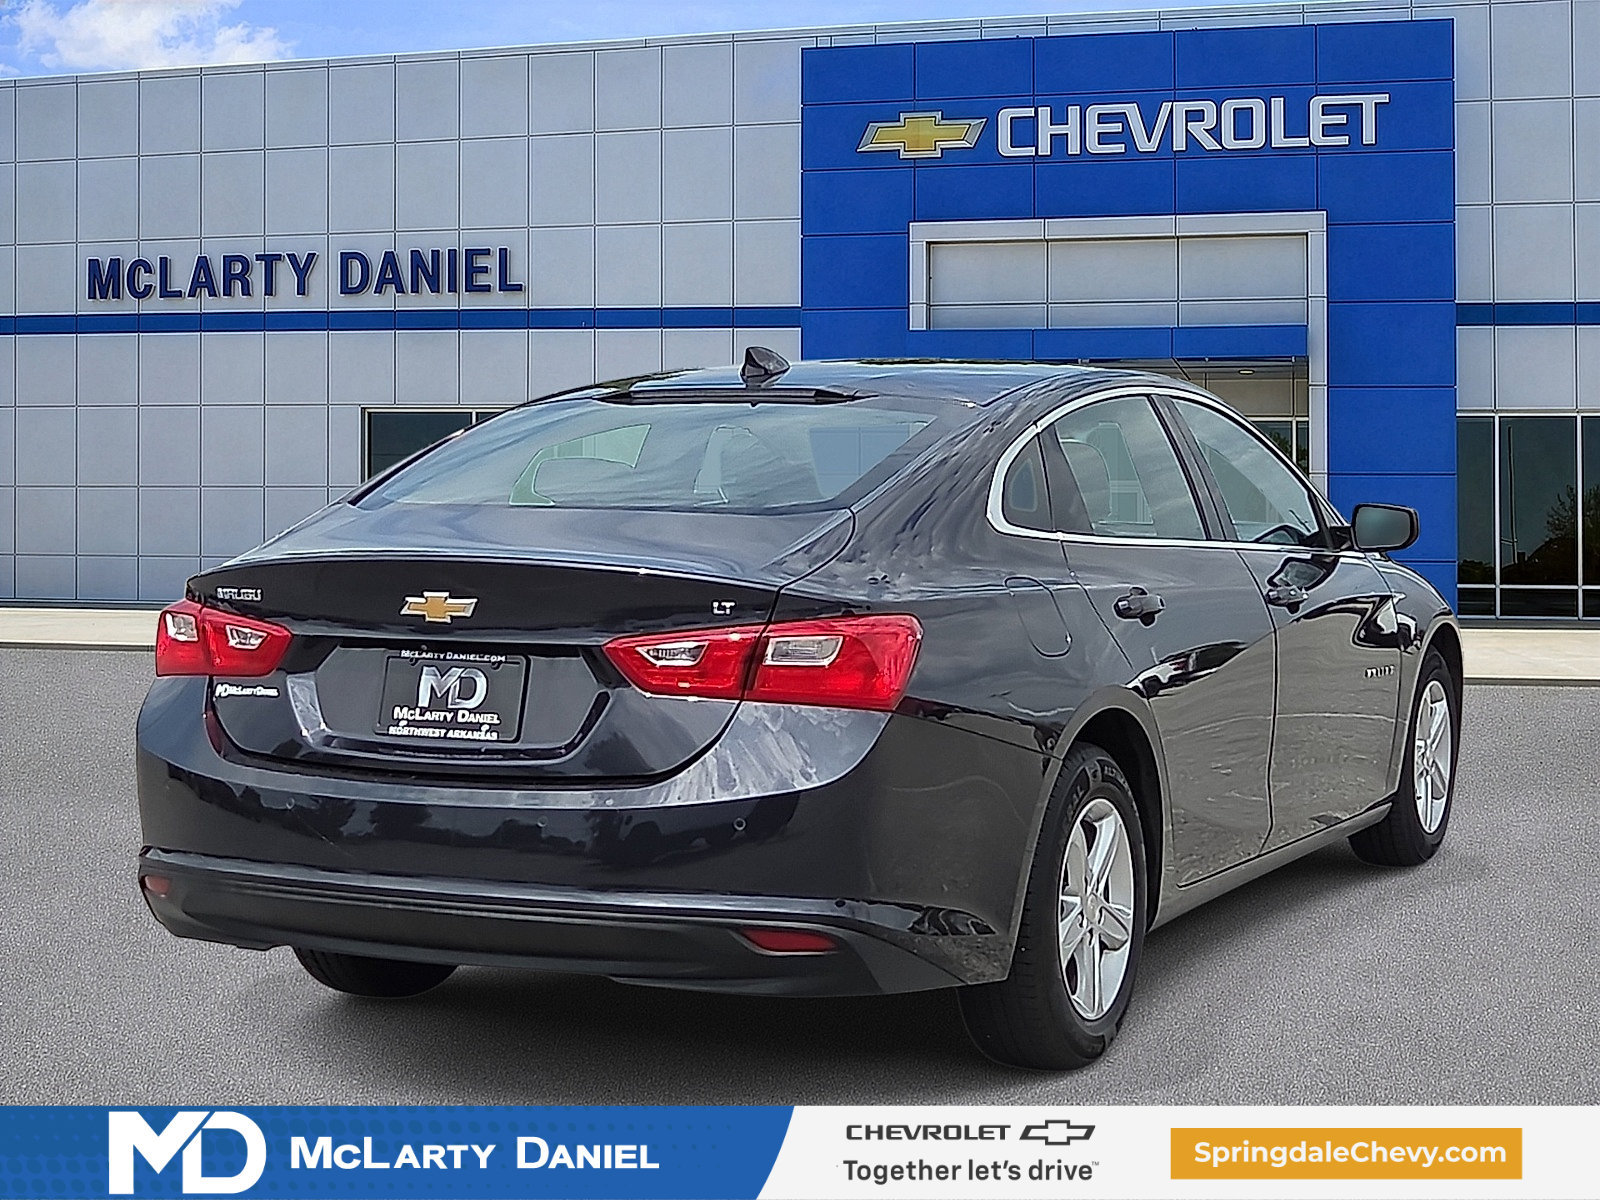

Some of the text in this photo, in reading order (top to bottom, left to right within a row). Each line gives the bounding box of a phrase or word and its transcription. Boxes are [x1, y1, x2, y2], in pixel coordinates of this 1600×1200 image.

[997, 93, 1390, 156] CHEVROLET
[337, 246, 525, 297] DANIEL
[713, 601, 735, 614] LT
[418, 666, 488, 709] MD
